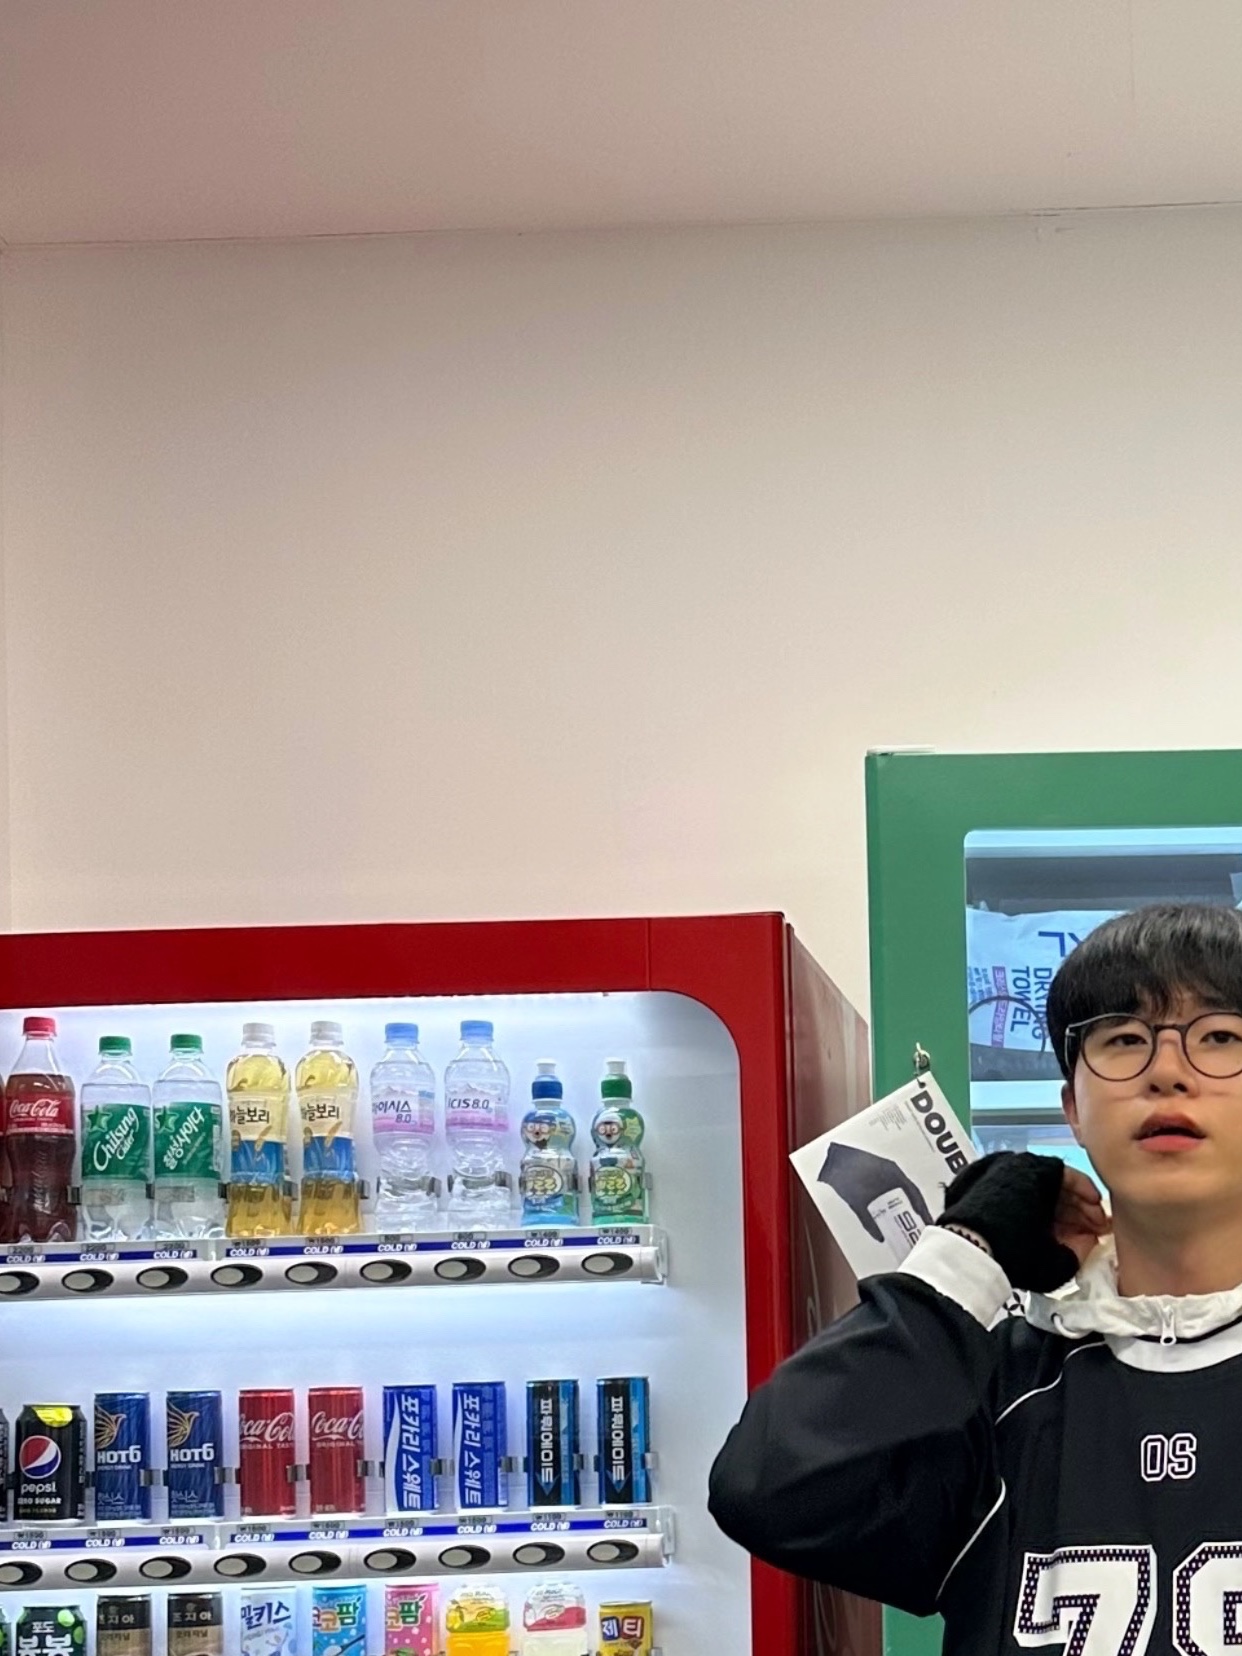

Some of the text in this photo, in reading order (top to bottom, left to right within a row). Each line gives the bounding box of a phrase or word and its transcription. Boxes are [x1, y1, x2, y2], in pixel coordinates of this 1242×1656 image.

[1010, 966, 1031, 1033] TOWEL
[471, 1098, 489, 1110] 8.0
[93, 1107, 140, 1171] Chilsung
[303, 1246, 329, 1255] COLD
[451, 1241, 476, 1250] COLD
[6, 1255, 31, 1264] COLD
[80, 1253, 105, 1262] COLD
[540, 1397, 553, 1484] 파워에이드
[611, 1396, 625, 1482] 파워에이드
[170, 1443, 214, 1462] HOT6
[401, 1393, 421, 1510] 포카리 스웨트
[463, 1392, 482, 1505] 포카리 스웨트
[1140, 1433, 1197, 1482] OS
[20, 1482, 57, 1496] pepsi
[34, 1497, 62, 1505] SUGAR
[383, 1528, 408, 1537] COLD
[530, 1522, 555, 1531] COLD
[12, 1541, 37, 1550] COLD
[85, 1538, 110, 1547] COLD
[240, 1600, 292, 1629] 밀키스
[32, 1622, 54, 1633] 포도
[601, 1616, 644, 1640] 제티
